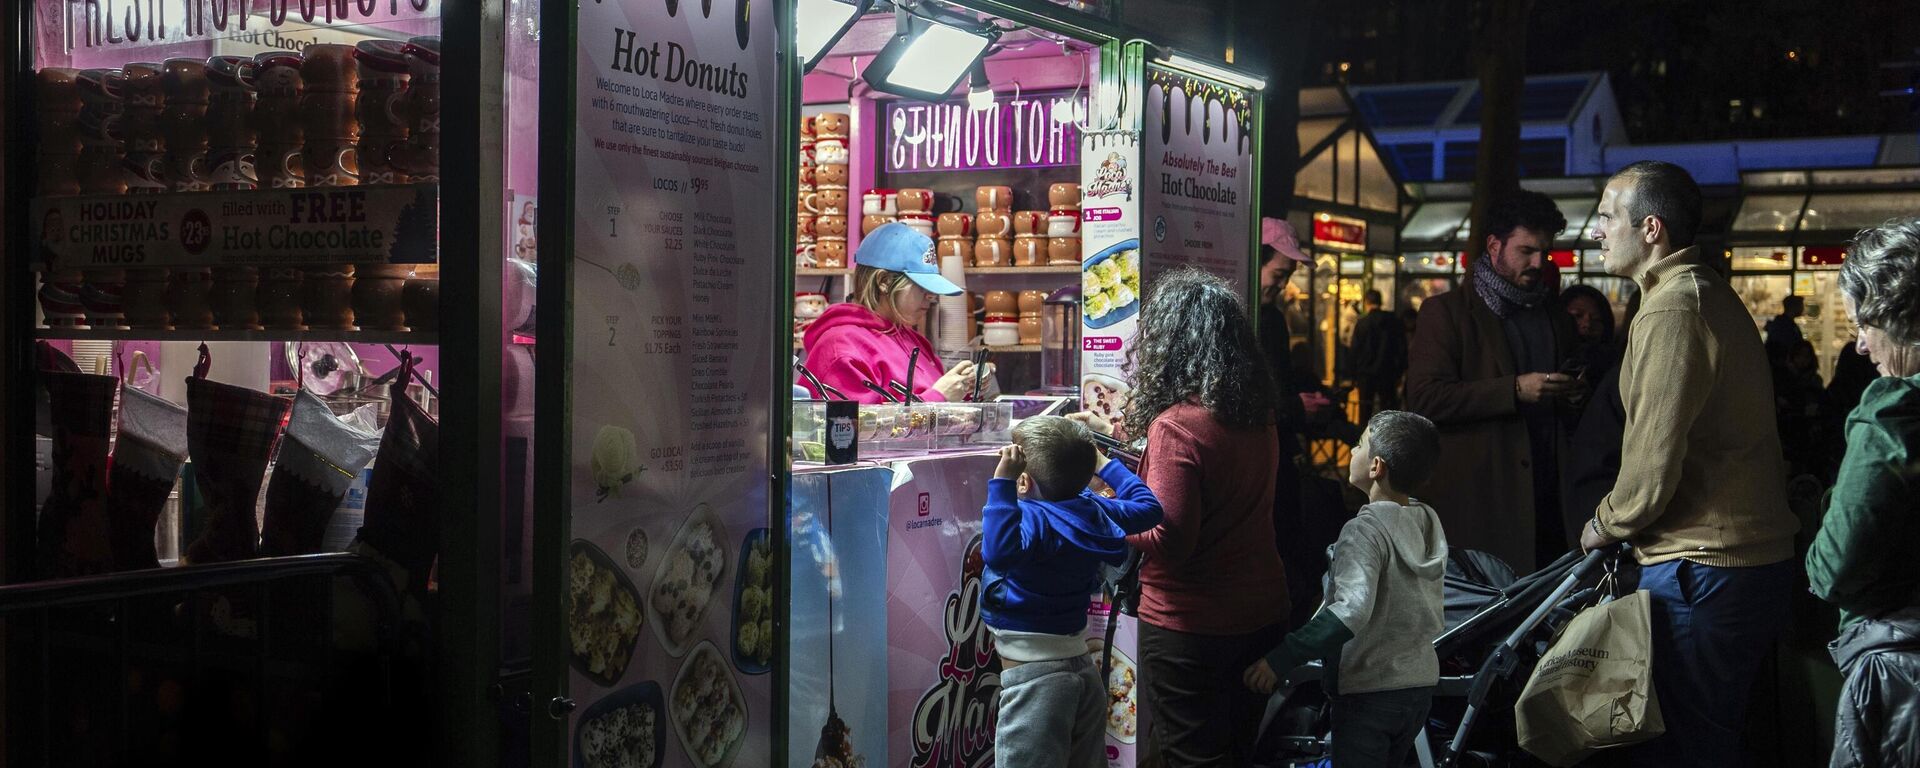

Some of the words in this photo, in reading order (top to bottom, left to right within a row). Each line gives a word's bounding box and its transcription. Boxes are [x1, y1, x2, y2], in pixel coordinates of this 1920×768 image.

[611, 27, 660, 79] Hot
[664, 41, 748, 99] Donuts
[596, 77, 631, 95] Welcome
[633, 86, 640, 97] to
[642, 88, 658, 100] Loca
[660, 91, 684, 106] Madres
[685, 97, 705, 110] where
[707, 104, 724, 117] every
[725, 106, 741, 118] order
[743, 111, 759, 121] starts
[592, 96, 608, 110] with
[610, 100, 615, 111] 6
[616, 103, 670, 124] mouthwatering
[711, 118, 726, 132] fresh
[727, 125, 744, 136] donut
[746, 127, 762, 139] holes
[612, 118, 627, 133] that
[629, 123, 641, 135] are
[642, 126, 657, 138] sure
[658, 128, 665, 139] to
[667, 130, 696, 145] tantalize
[697, 136, 711, 148] your
[712, 137, 727, 150] taste
[594, 138, 605, 149] We
[606, 141, 617, 151] use
[618, 142, 631, 155] only
[632, 144, 642, 155] the
[643, 145, 659, 158] finest
[660, 149, 691, 165] sustainably
[1162, 151, 1205, 177] Absolutely
[1207, 159, 1219, 175] The
[1221, 162, 1237, 178] Best
[654, 176, 678, 191] LOCOS
[1161, 173, 1183, 196] Hot
[1184, 177, 1237, 205] Chocolate
[80, 200, 158, 221] HOLIDAY
[222, 201, 253, 217] filled
[256, 200, 286, 216] with
[290, 191, 366, 224] FREE
[607, 206, 620, 216] STEP
[659, 211, 683, 223] CHOOSE
[1085, 211, 1091, 220] 1
[69, 222, 169, 243] CHRISTMAS
[223, 225, 262, 250] Hot
[268, 224, 384, 250] Chocolate
[610, 218, 617, 237] 1
[644, 223, 660, 233] YOUR
[661, 225, 683, 236] SAUCES
[664, 238, 683, 250] $2.25
[91, 244, 146, 264] MUGS
[651, 315, 664, 325] PICK
[665, 315, 682, 326] YOUR
[608, 327, 616, 346] 2
[653, 329, 681, 339] TOPPINGS
[644, 342, 663, 354] $1.75
[664, 342, 681, 354] Each
[1085, 340, 1091, 348] 2
[835, 422, 851, 432] TIPS
[651, 447, 662, 459] GO
